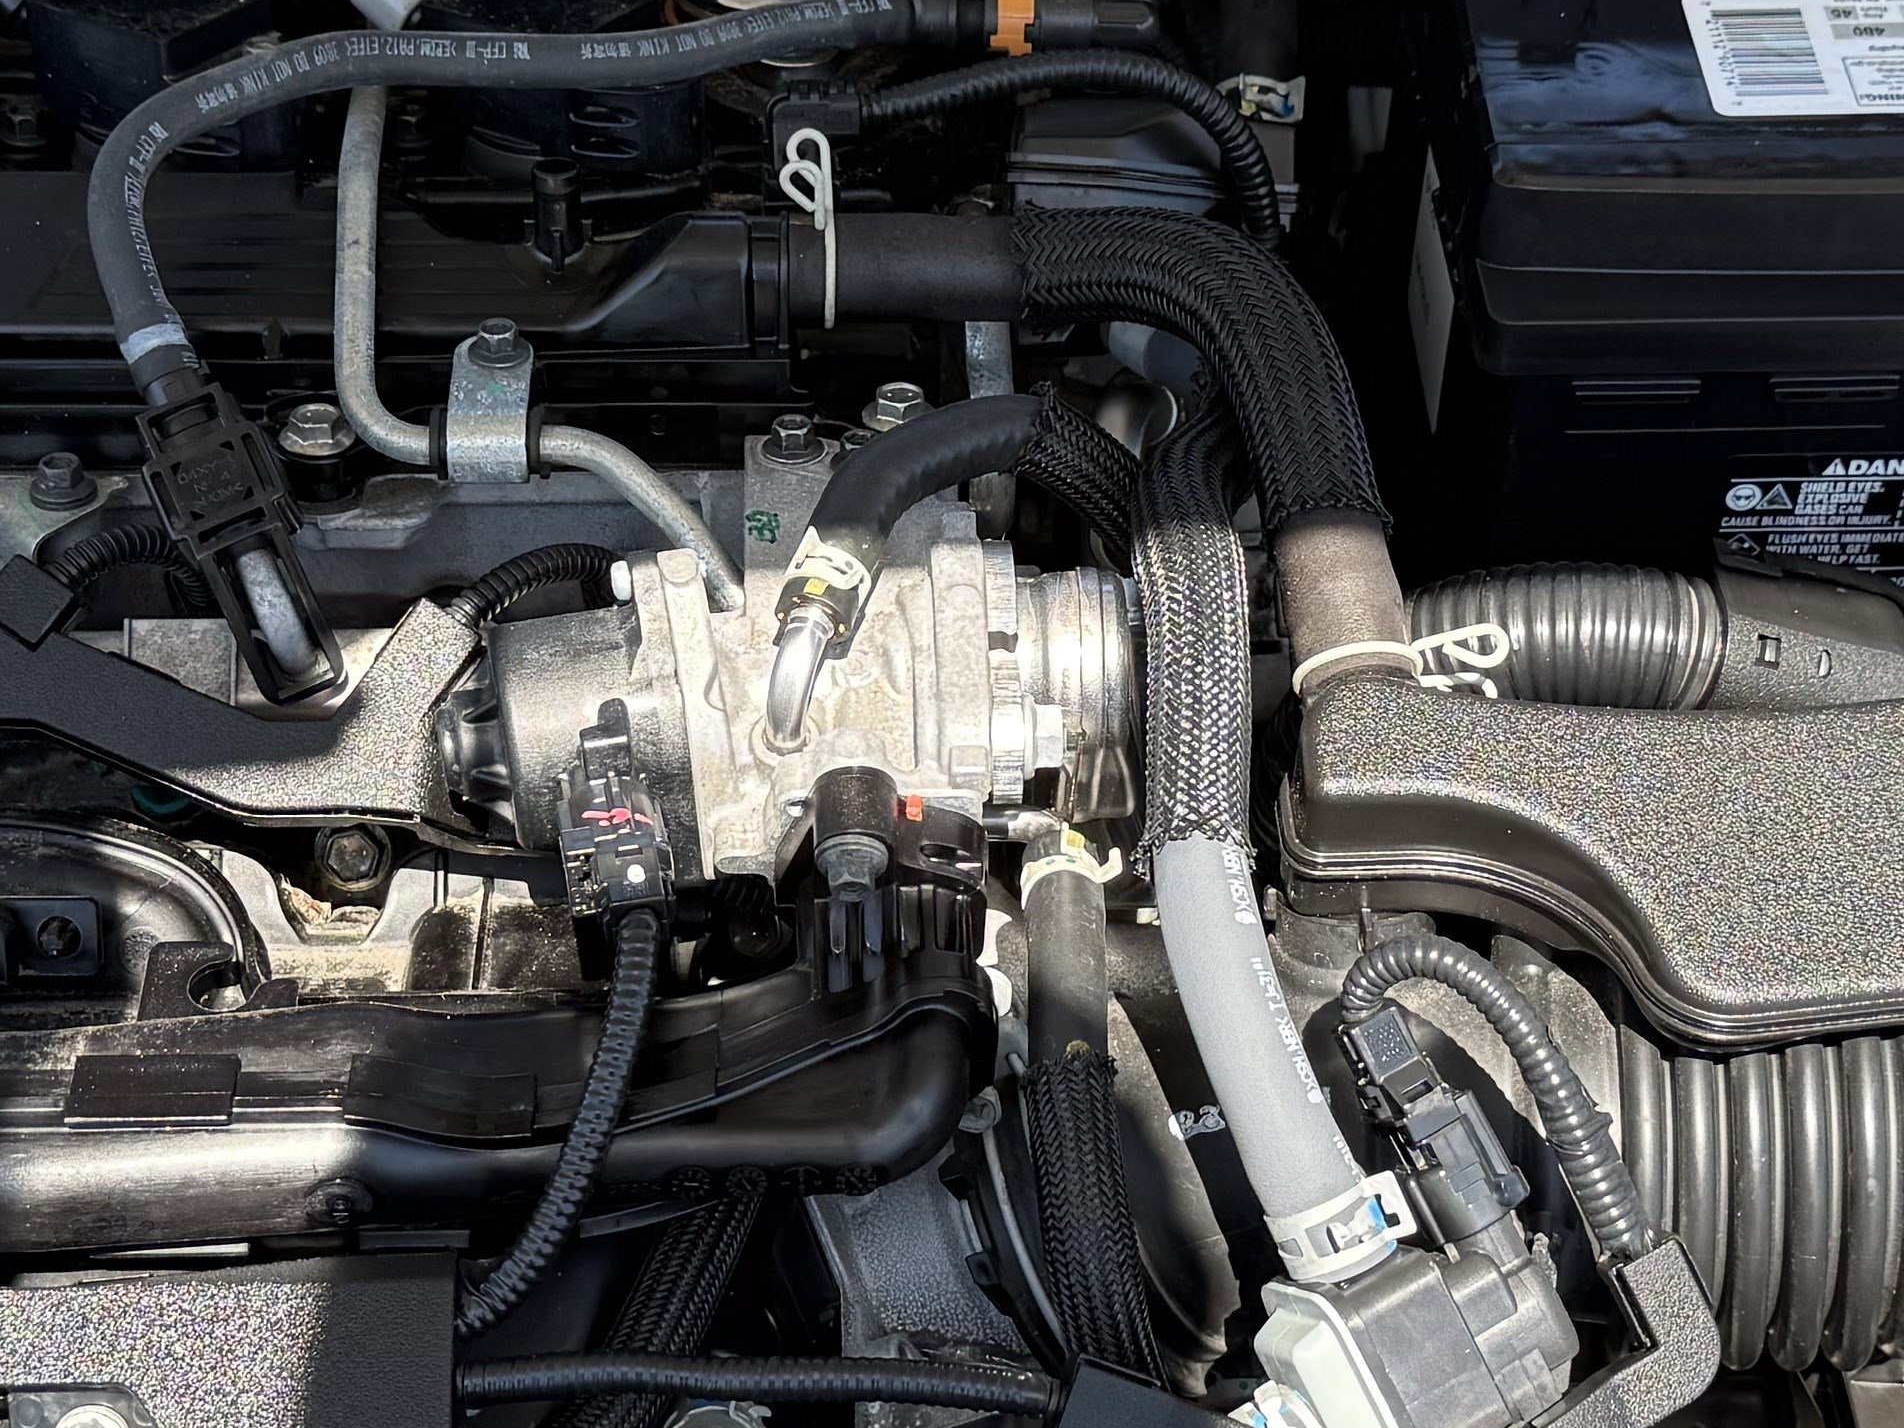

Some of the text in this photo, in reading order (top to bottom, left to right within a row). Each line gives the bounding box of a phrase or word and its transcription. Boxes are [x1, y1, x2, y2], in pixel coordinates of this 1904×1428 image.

[638, 38, 671, 57] KINK
[678, 34, 699, 53] NOT
[271, 60, 293, 83] NOT
[240, 73, 270, 94] KINK
[1800, 481, 1847, 493] SHIELD
[1797, 493, 1870, 504] EXPLOSIVE
[1795, 504, 1864, 515] GASES CAN
[1721, 514, 1893, 527] CAUSE BLINDNESS OR INJURY.
[1767, 533, 1808, 544] FLUSH
[1808, 533, 1839, 544] EYES
[1765, 545, 1797, 555] WITH
[1845, 544, 1870, 554] GET
[1848, 554, 1882, 564] FAST.
